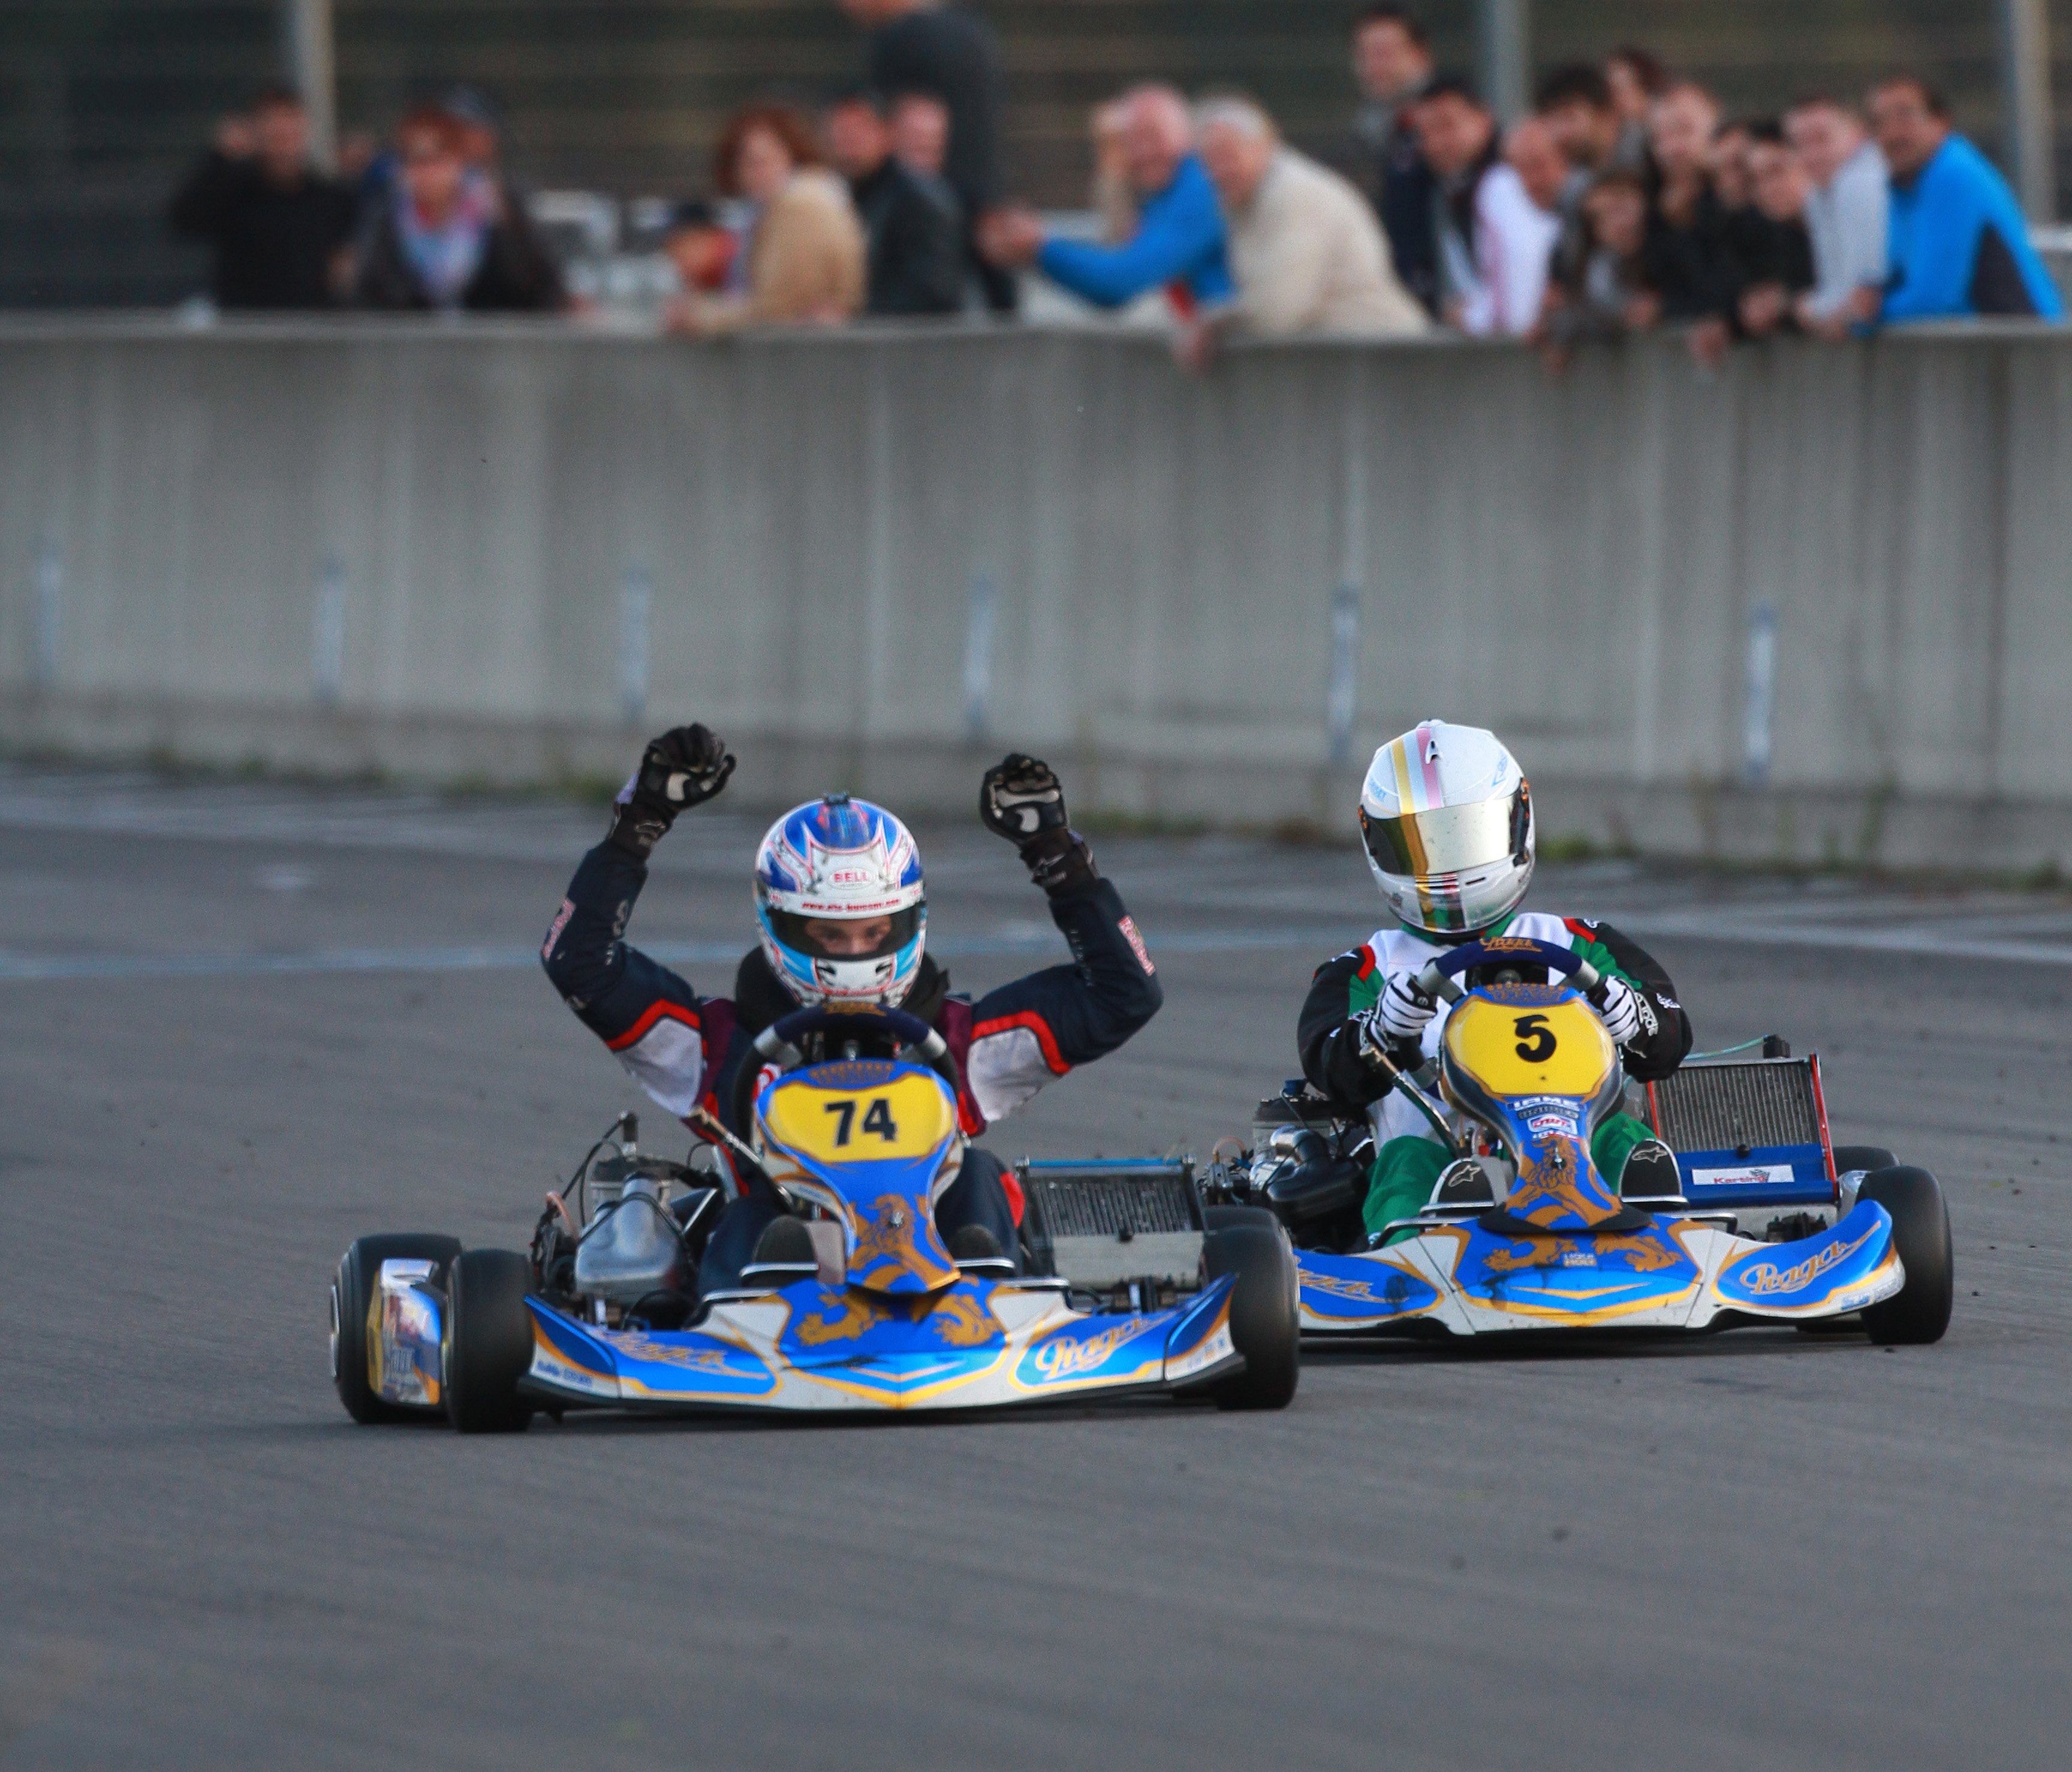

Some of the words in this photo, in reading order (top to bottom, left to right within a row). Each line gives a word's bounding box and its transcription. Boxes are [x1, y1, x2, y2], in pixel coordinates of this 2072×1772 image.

[834, 872, 868, 882] BELL
[1513, 1014, 1557, 1063] 5
[824, 1098, 897, 1148] 74
